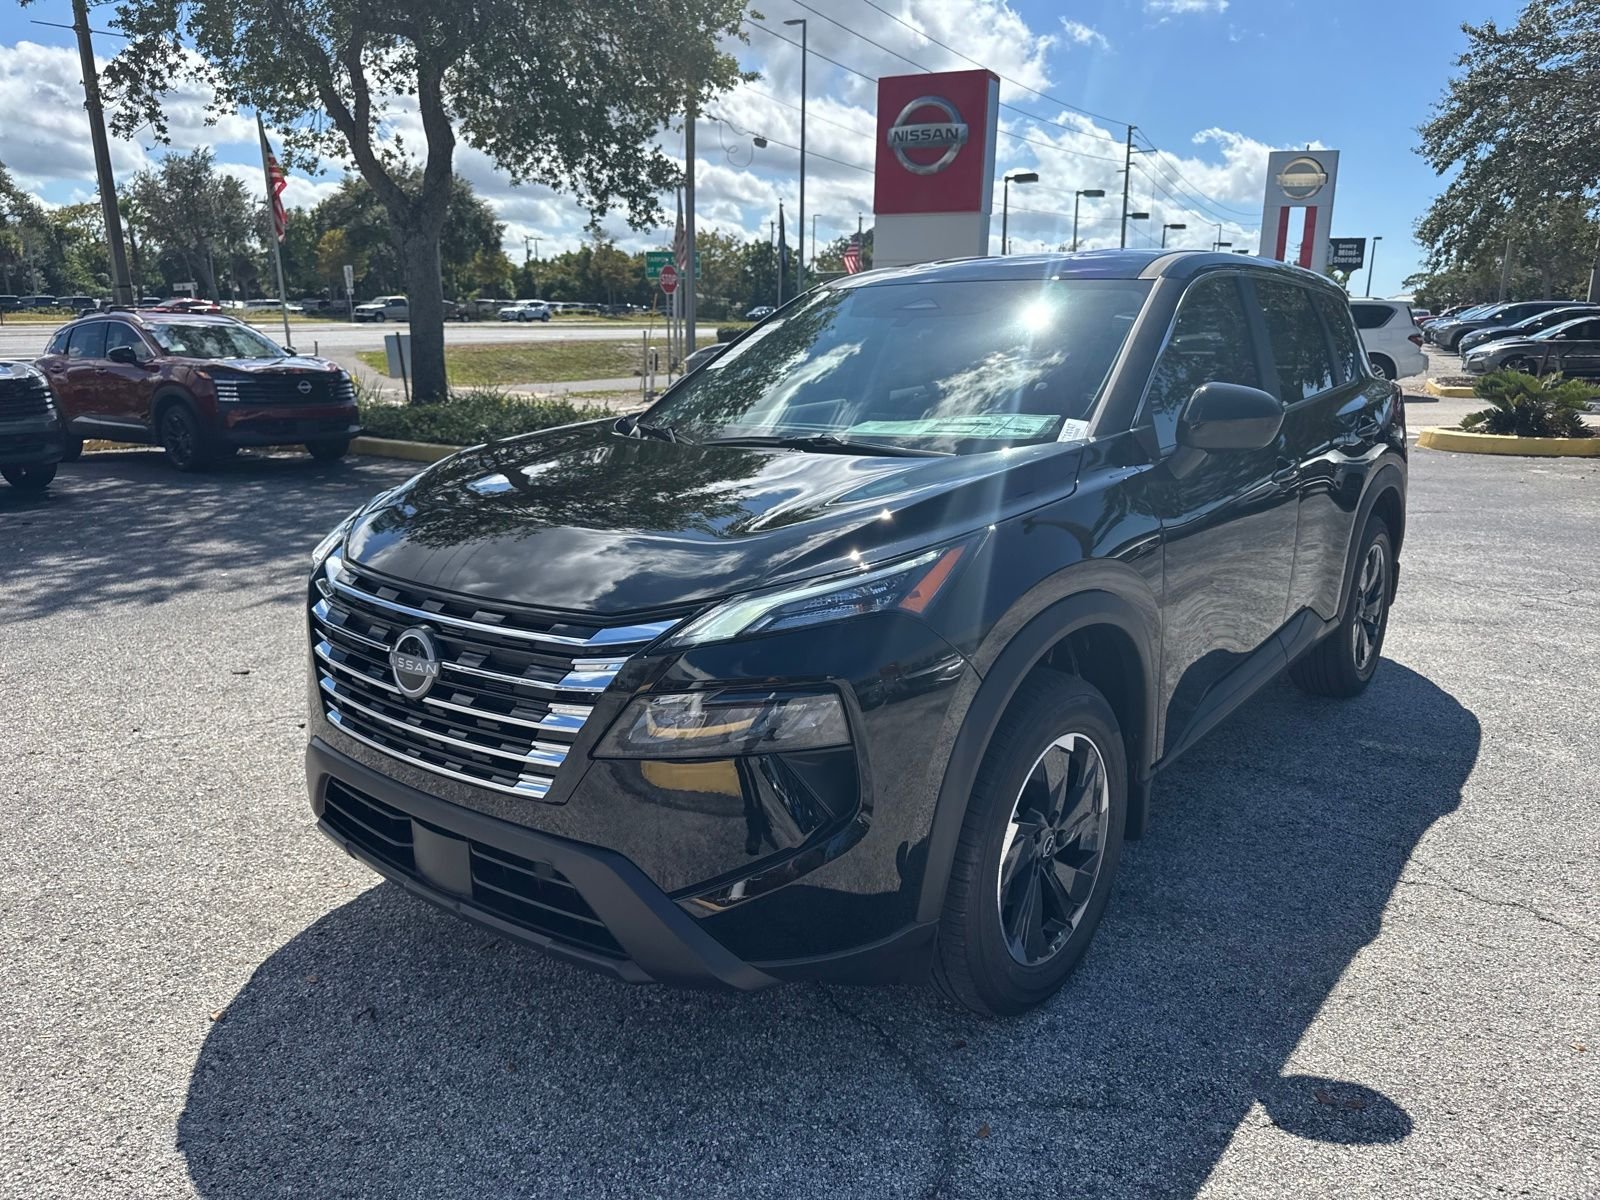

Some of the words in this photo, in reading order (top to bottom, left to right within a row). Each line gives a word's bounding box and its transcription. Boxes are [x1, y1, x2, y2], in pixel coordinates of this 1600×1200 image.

[892, 127, 959, 142] NISSAN
[1333, 256, 1362, 264] Storage
[661, 273, 676, 285] STOP
